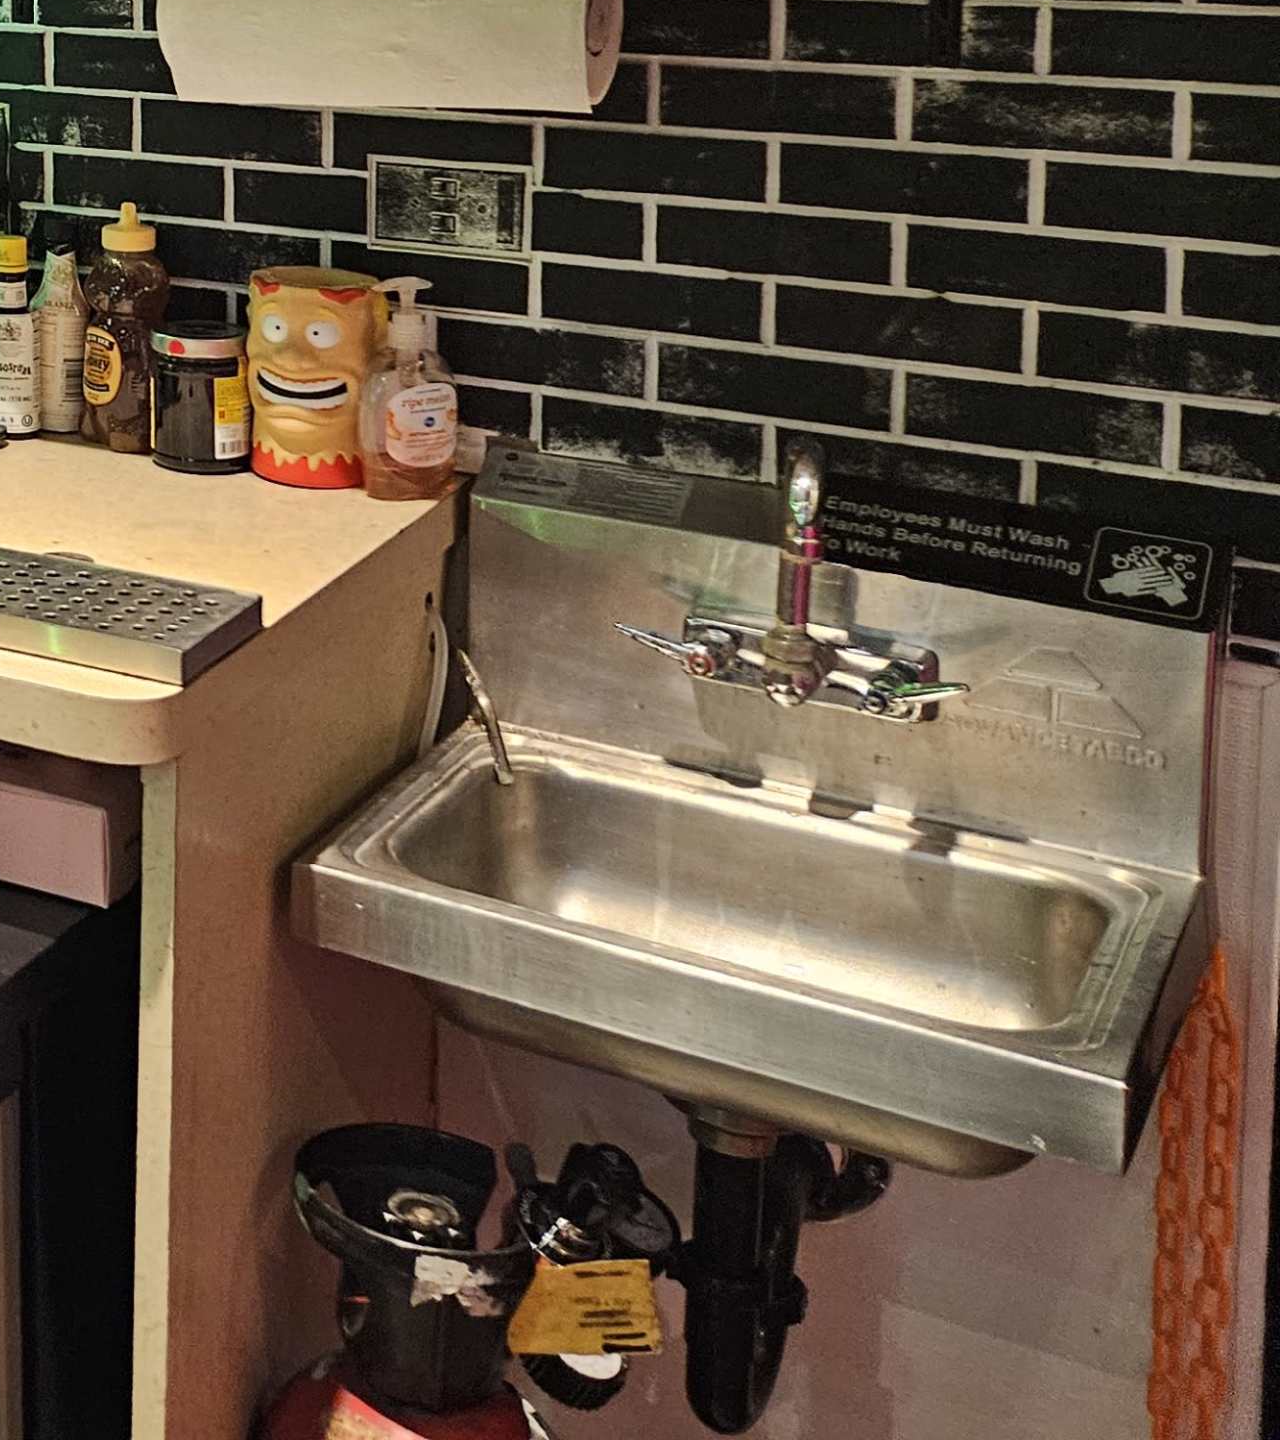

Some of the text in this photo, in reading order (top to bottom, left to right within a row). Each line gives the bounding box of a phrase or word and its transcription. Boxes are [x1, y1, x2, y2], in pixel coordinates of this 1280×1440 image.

[822, 515, 1083, 578] Hands Before Returning
[825, 496, 1070, 551] Employees Must Wash
[846, 537, 902, 562] Work
